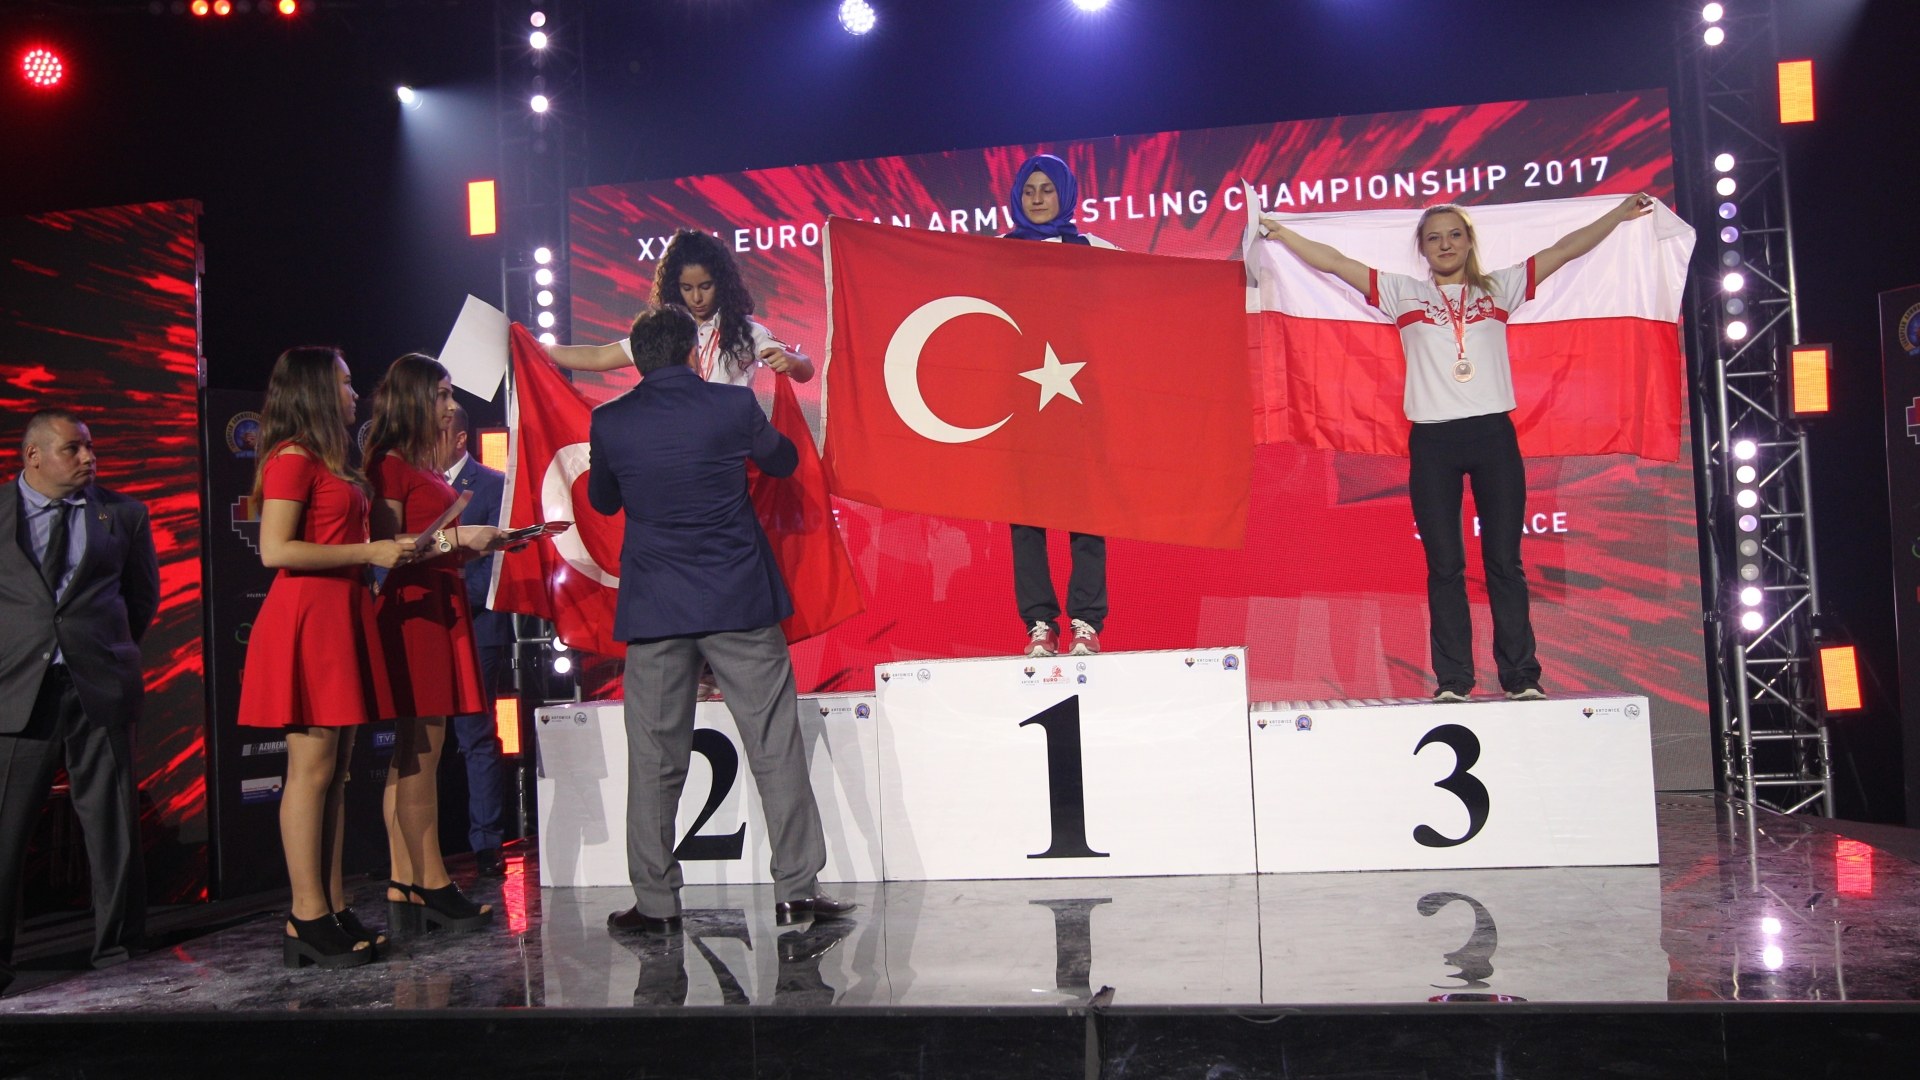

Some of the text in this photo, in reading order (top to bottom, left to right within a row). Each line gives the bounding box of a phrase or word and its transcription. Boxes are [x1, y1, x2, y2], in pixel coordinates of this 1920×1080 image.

[1224, 165, 1507, 211] CHAMPIONSHIP
[1524, 156, 1609, 188] 2017
[673, 727, 747, 860] 2
[1018, 694, 1111, 859] 1
[1412, 723, 1490, 848] 3
